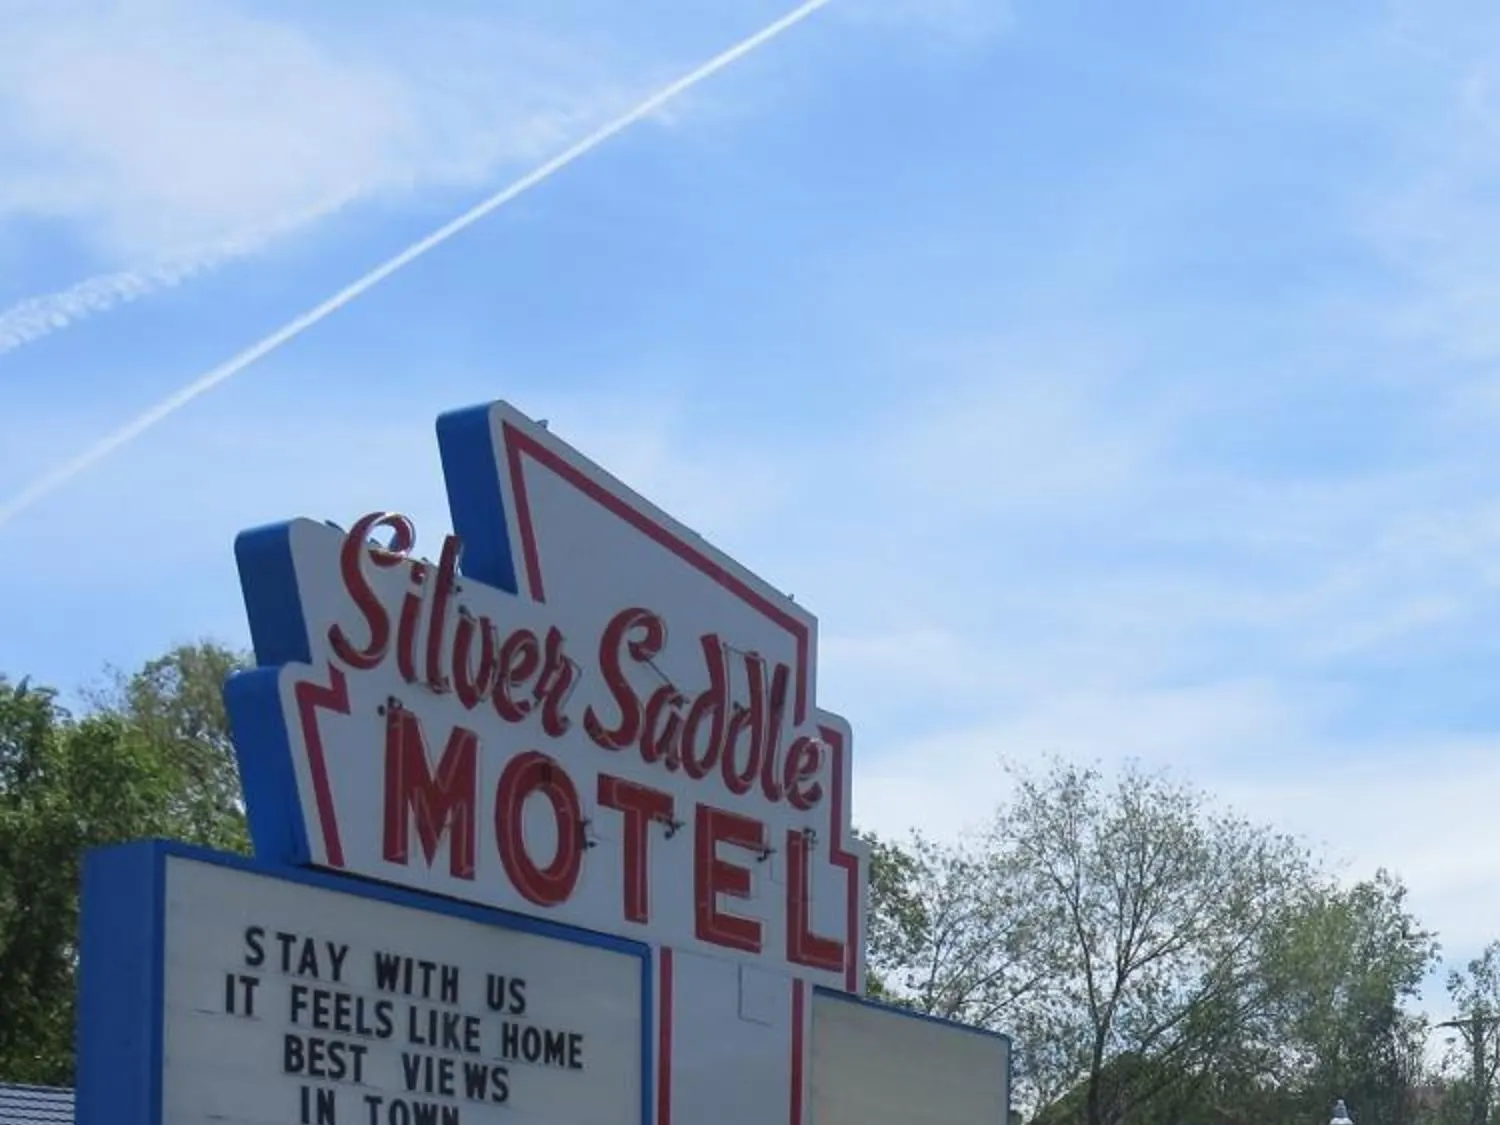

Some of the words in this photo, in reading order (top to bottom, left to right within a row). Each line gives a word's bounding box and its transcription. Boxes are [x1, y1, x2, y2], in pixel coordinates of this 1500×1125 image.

[328, 511, 582, 737] Silver
[583, 607, 826, 811] Saddle
[382, 705, 846, 972] MOTEL
[244, 926, 351, 982] STAY
[374, 952, 460, 1004] WITH
[486, 974, 527, 1016] US
[225, 973, 260, 1017] IT
[290, 985, 394, 1039] FEELS
[408, 1008, 481, 1053] LIKE
[502, 1022, 585, 1070] HOME
[283, 1034, 369, 1083] BEST
[402, 1052, 510, 1102] VIEWS
